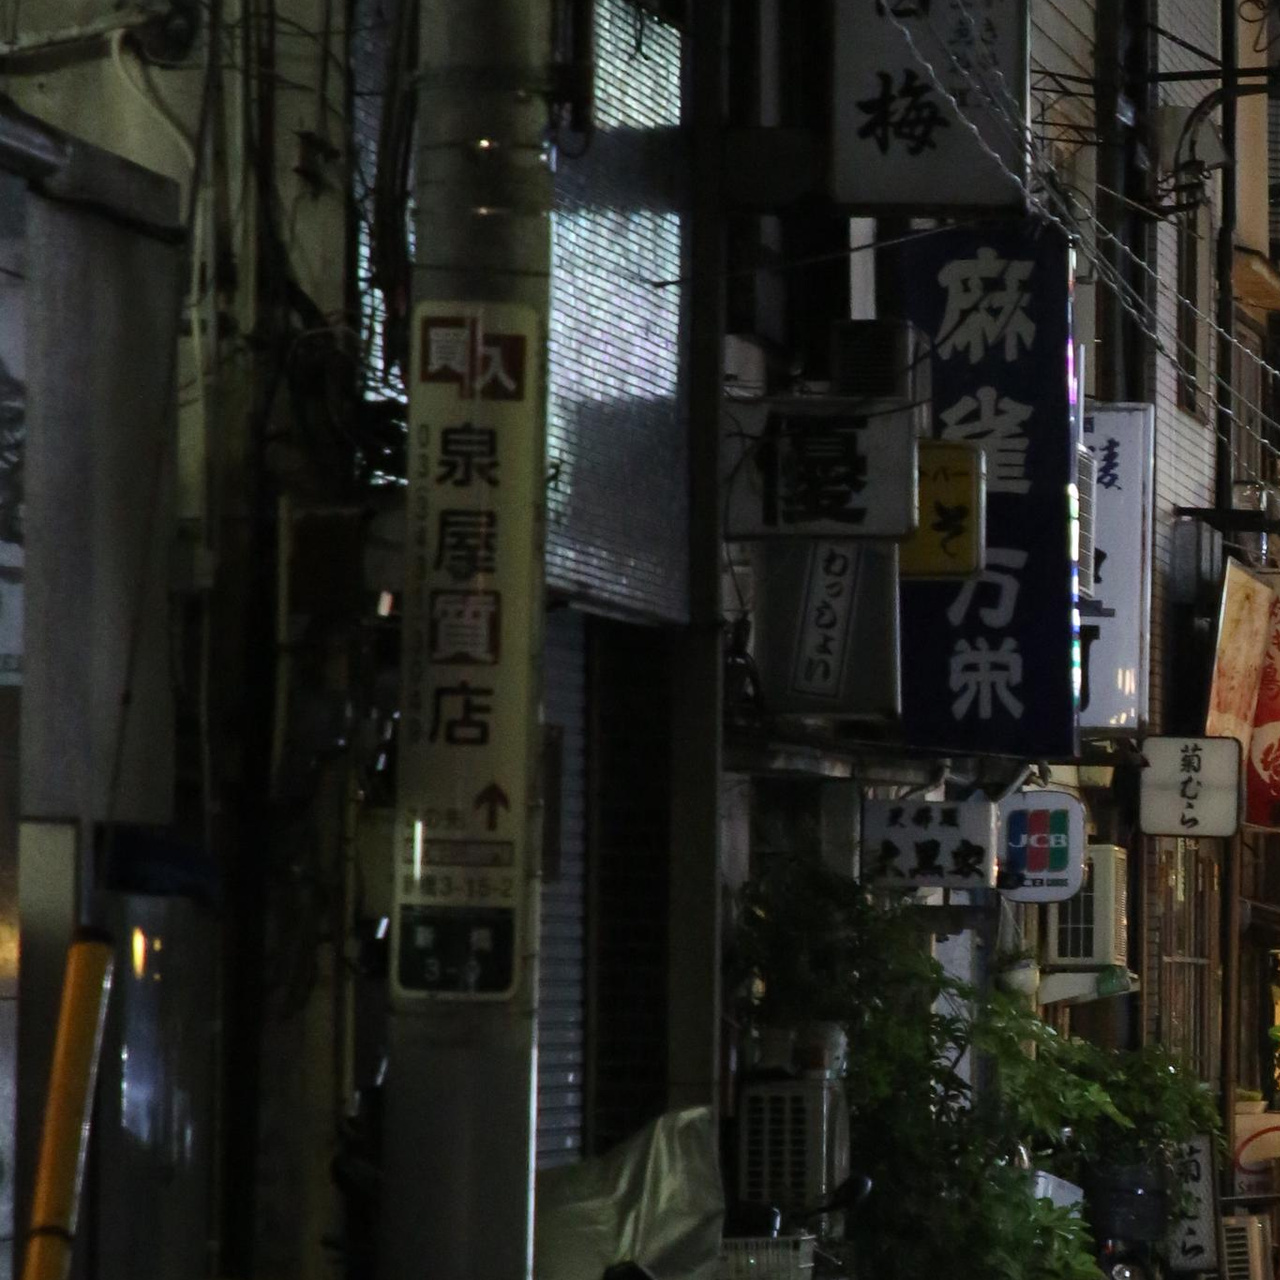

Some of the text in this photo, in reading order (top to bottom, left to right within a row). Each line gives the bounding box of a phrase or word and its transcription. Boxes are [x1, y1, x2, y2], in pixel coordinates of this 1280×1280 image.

[762, 410, 868, 528] 優
[430, 424, 500, 745] 泉屋質店
[1180, 743, 1203, 829] 菊むら
[1007, 833, 1070, 848] JCB
